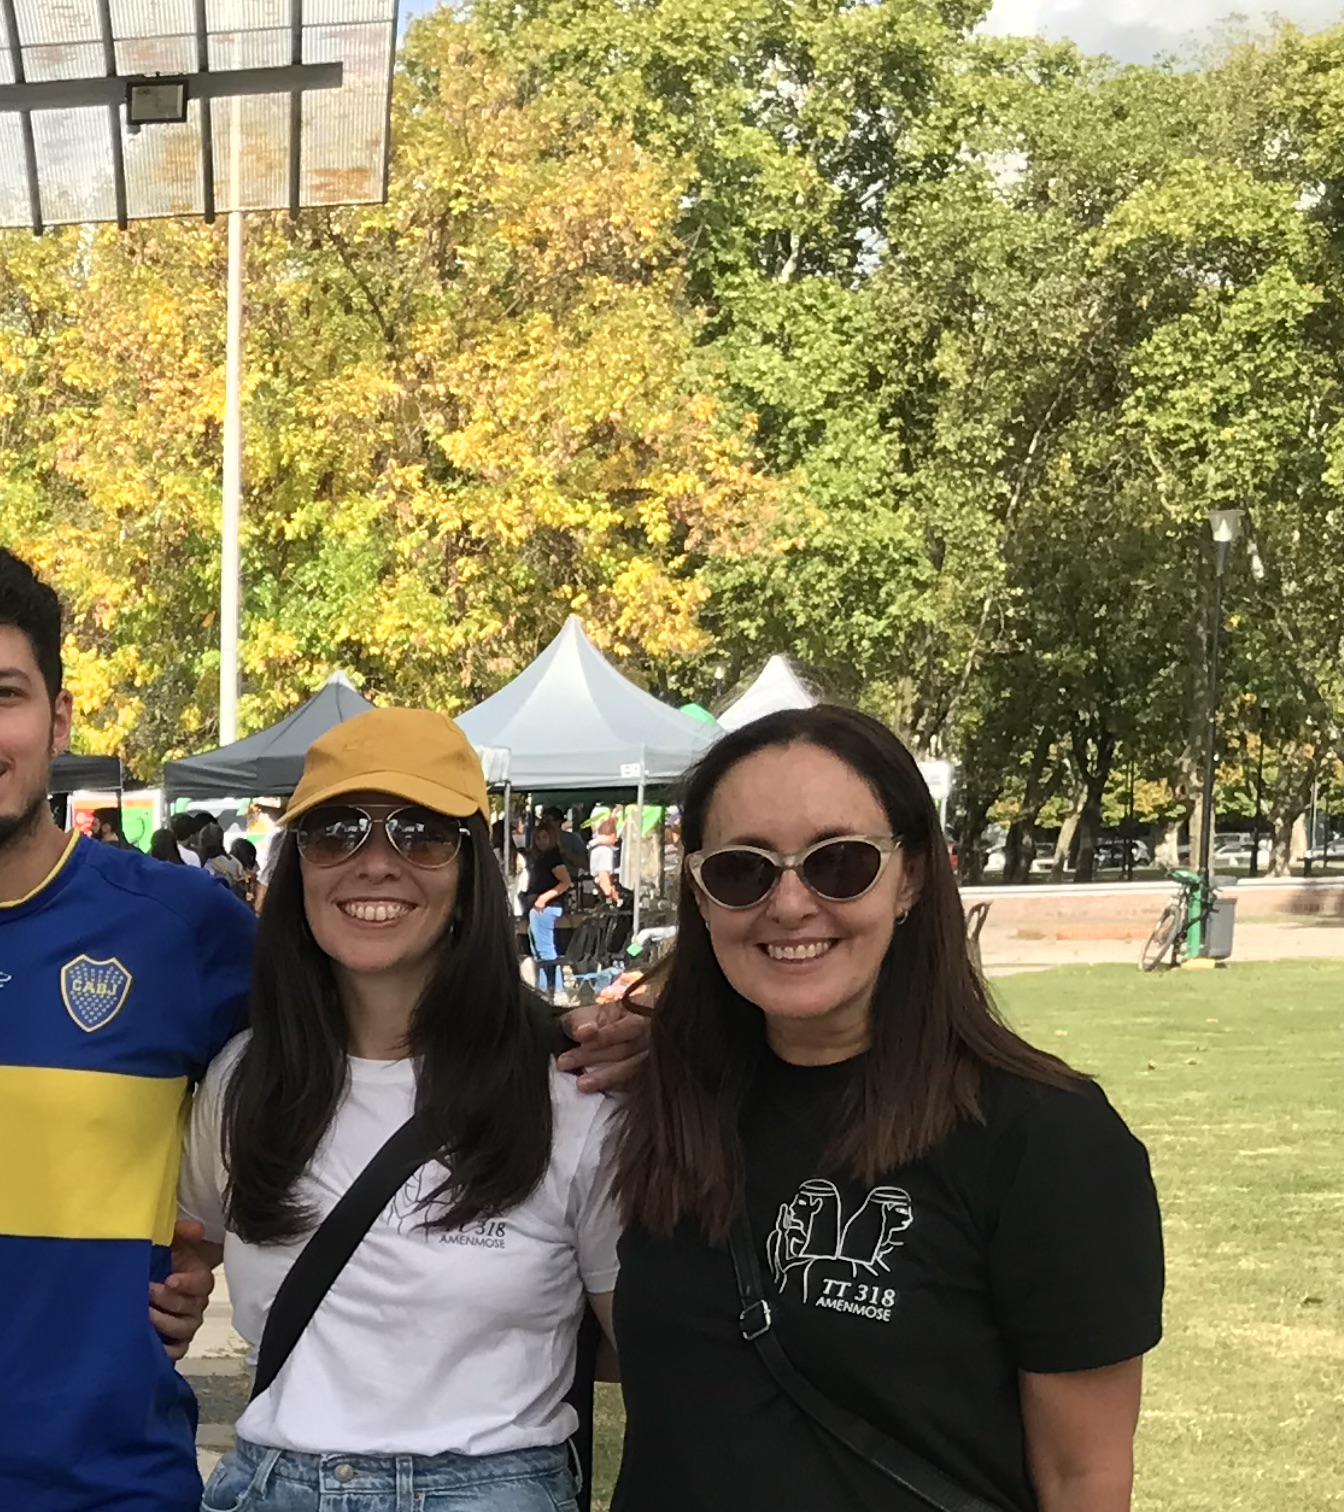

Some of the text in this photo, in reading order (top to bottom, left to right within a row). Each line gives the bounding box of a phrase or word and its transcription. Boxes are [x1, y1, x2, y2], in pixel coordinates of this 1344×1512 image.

[439, 1234, 506, 1249] AMENMOSE
[823, 1278, 896, 1307] TT 318
[815, 1297, 892, 1322] AMENMOSE
